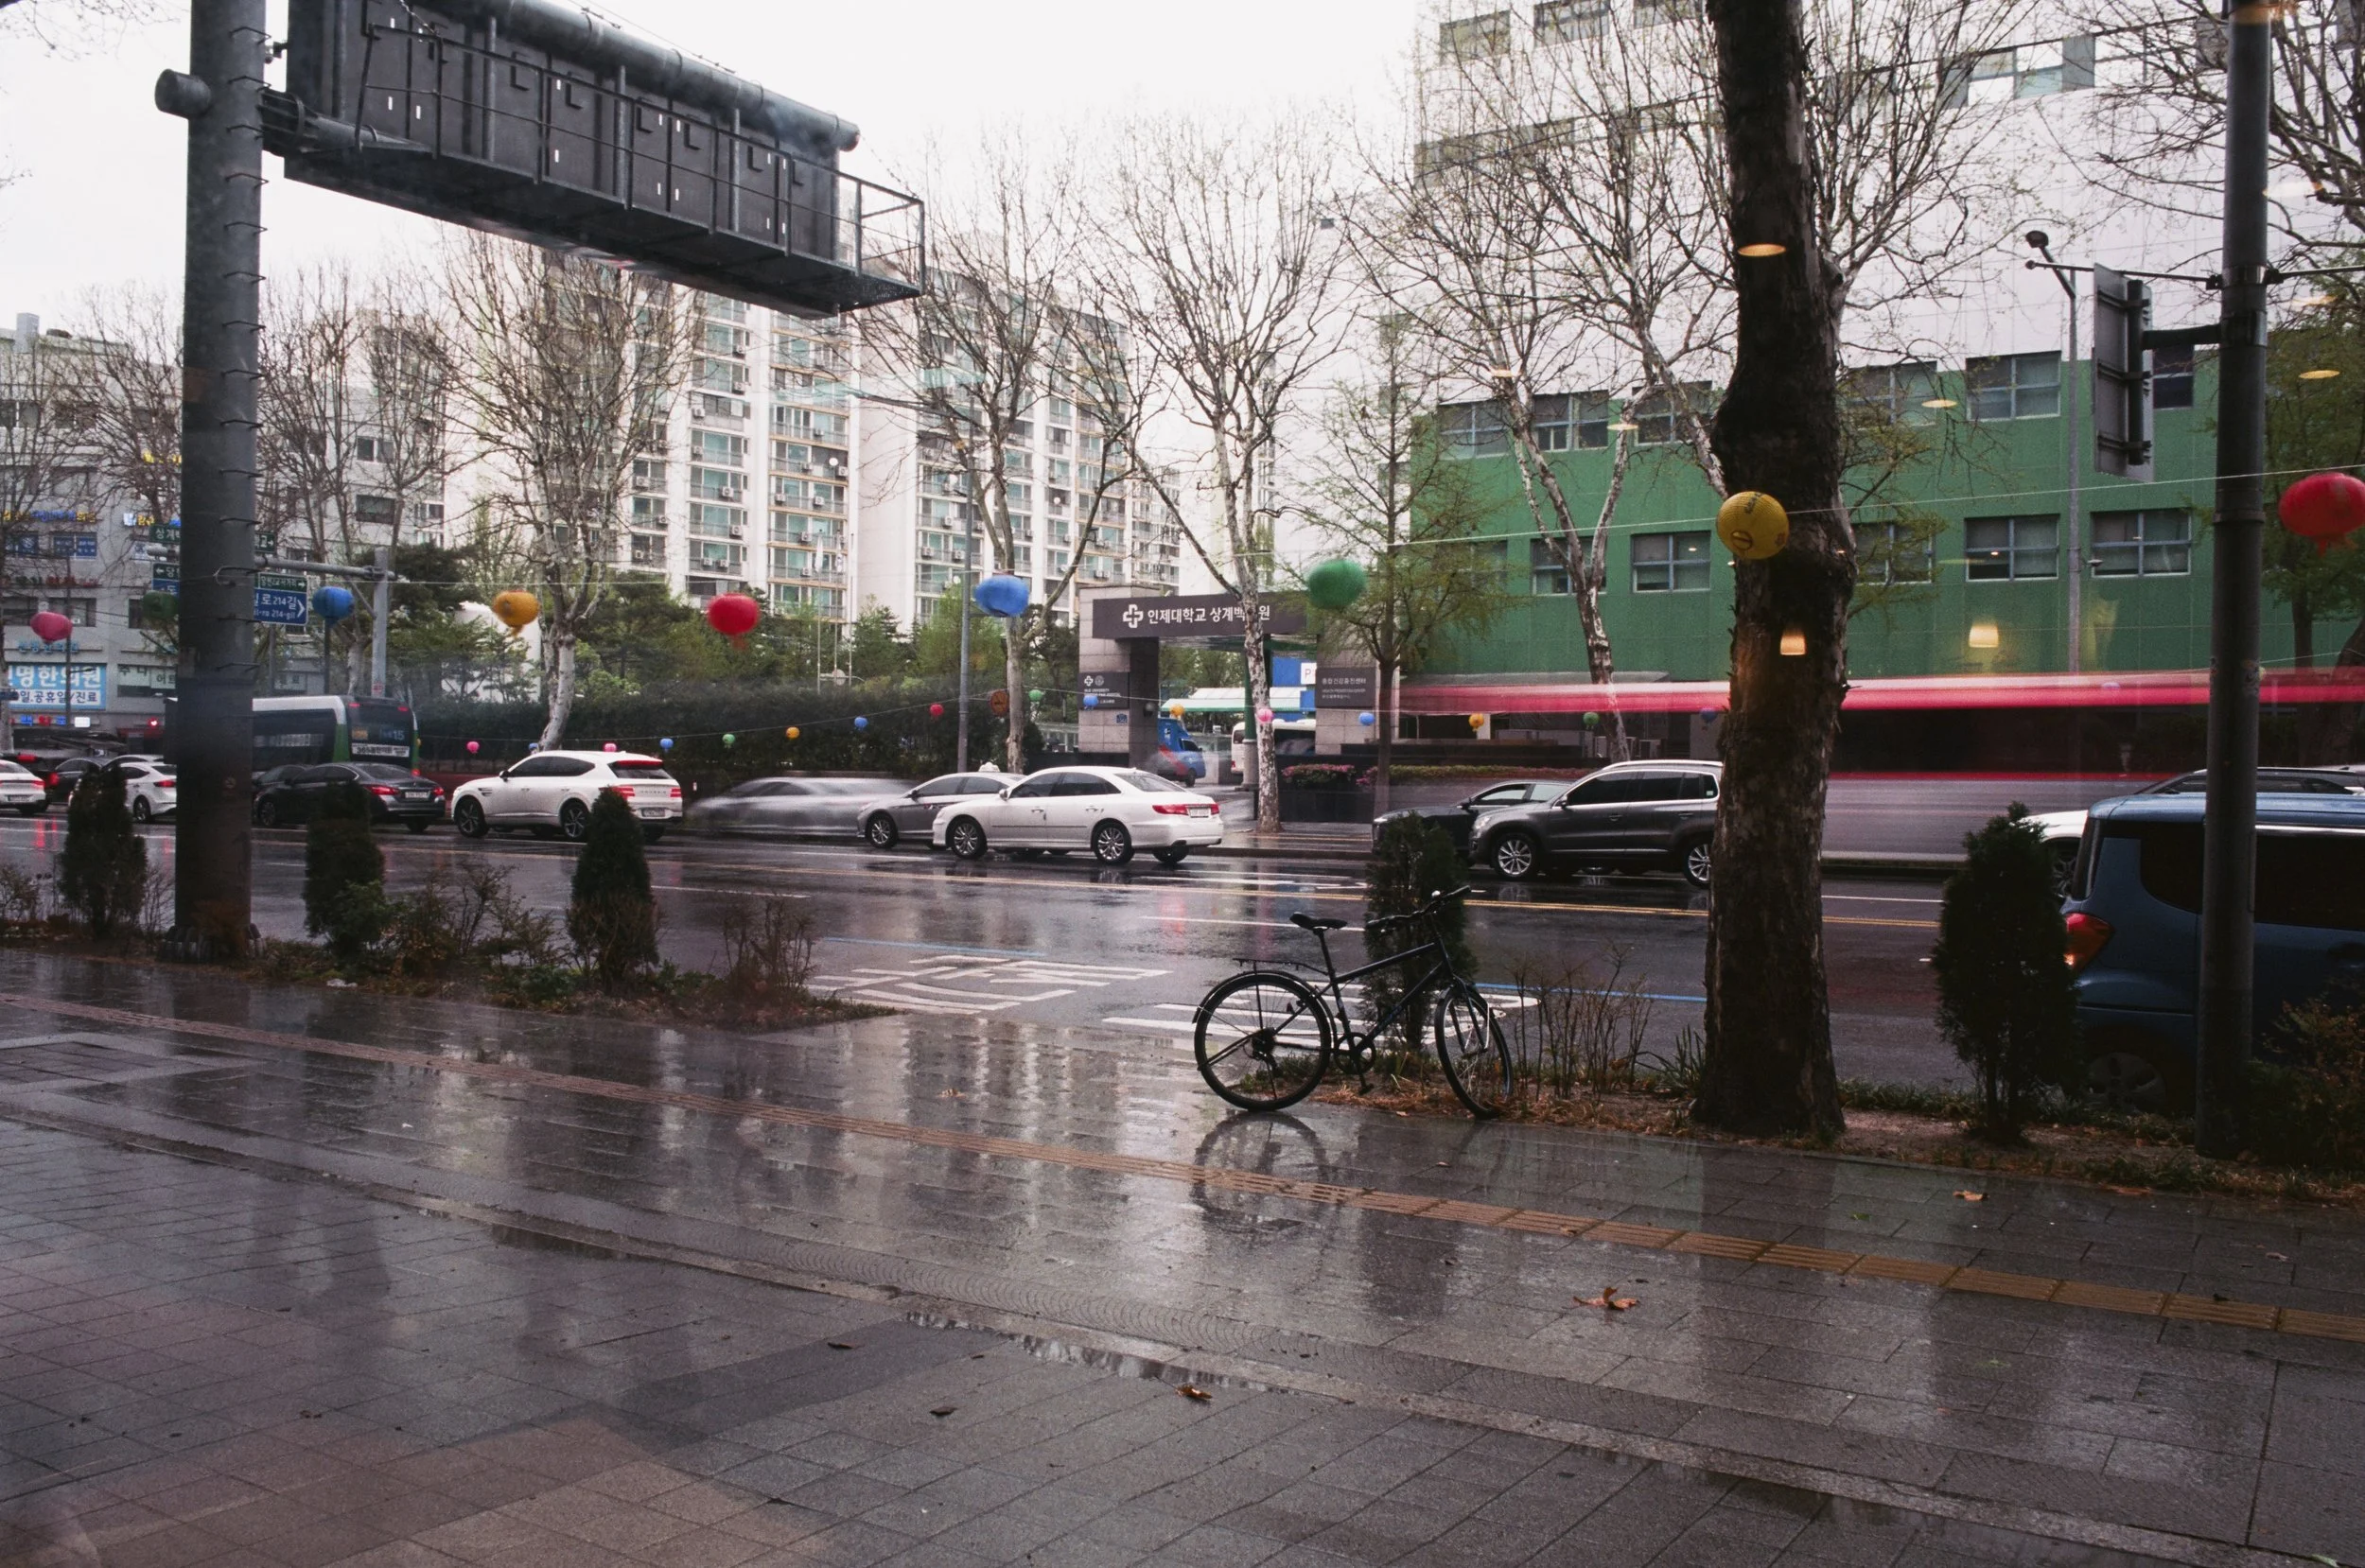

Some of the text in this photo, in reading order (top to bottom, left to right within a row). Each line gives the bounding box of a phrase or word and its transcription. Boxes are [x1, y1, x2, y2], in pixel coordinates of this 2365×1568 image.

[1147, 605, 1270, 624] 인제대학교 상계백원
[20, 690, 97, 704] 일.공휴일/진료
